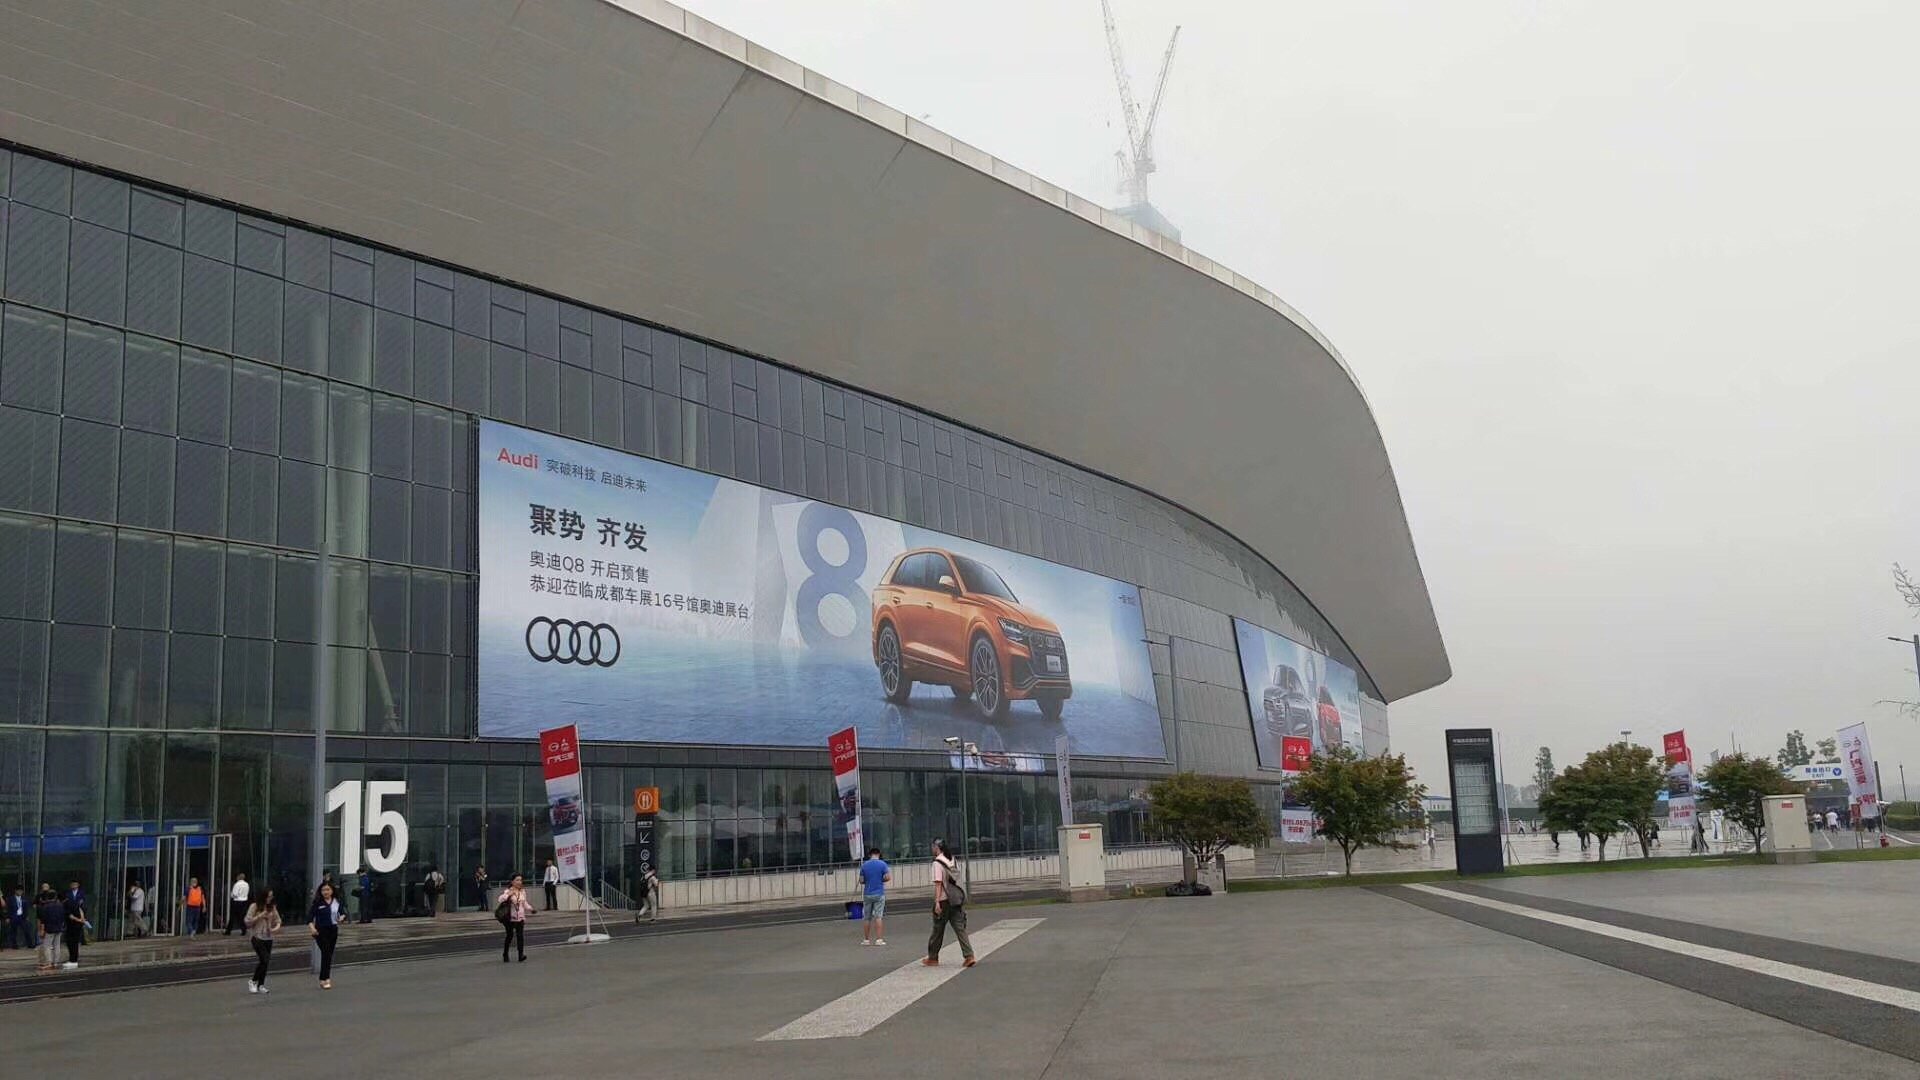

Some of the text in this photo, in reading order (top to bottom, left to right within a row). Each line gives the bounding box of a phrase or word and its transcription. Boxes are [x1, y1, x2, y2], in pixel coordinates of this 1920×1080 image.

[497, 447, 539, 470] Audi
[547, 458, 648, 494] 突破科技 启迪未来
[529, 502, 648, 553] 聚势 齐发
[529, 550, 650, 584] 奥迪Q8 开启预售
[529, 574, 750, 620] 恭迎莅临成都车展16号馆奥迪展台
[324, 779, 409, 874] 15
